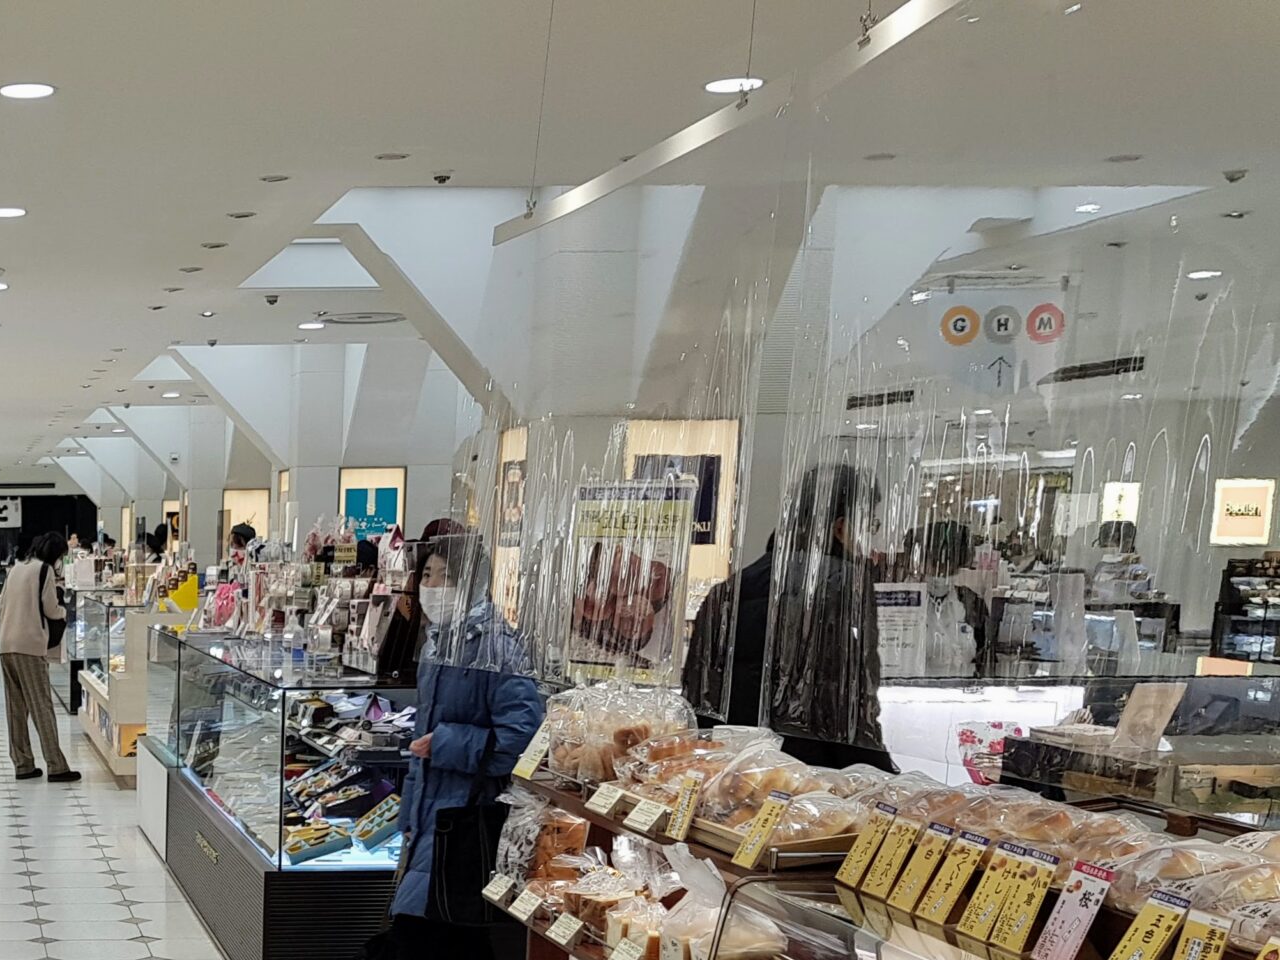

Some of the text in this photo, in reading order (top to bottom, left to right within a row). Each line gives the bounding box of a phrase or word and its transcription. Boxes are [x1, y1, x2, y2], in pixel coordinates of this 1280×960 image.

[953, 316, 1053, 333] G H M
[1023, 876, 1040, 907] 小倉
[1078, 889, 1095, 910] 桜
[1141, 914, 1165, 944] 五色
